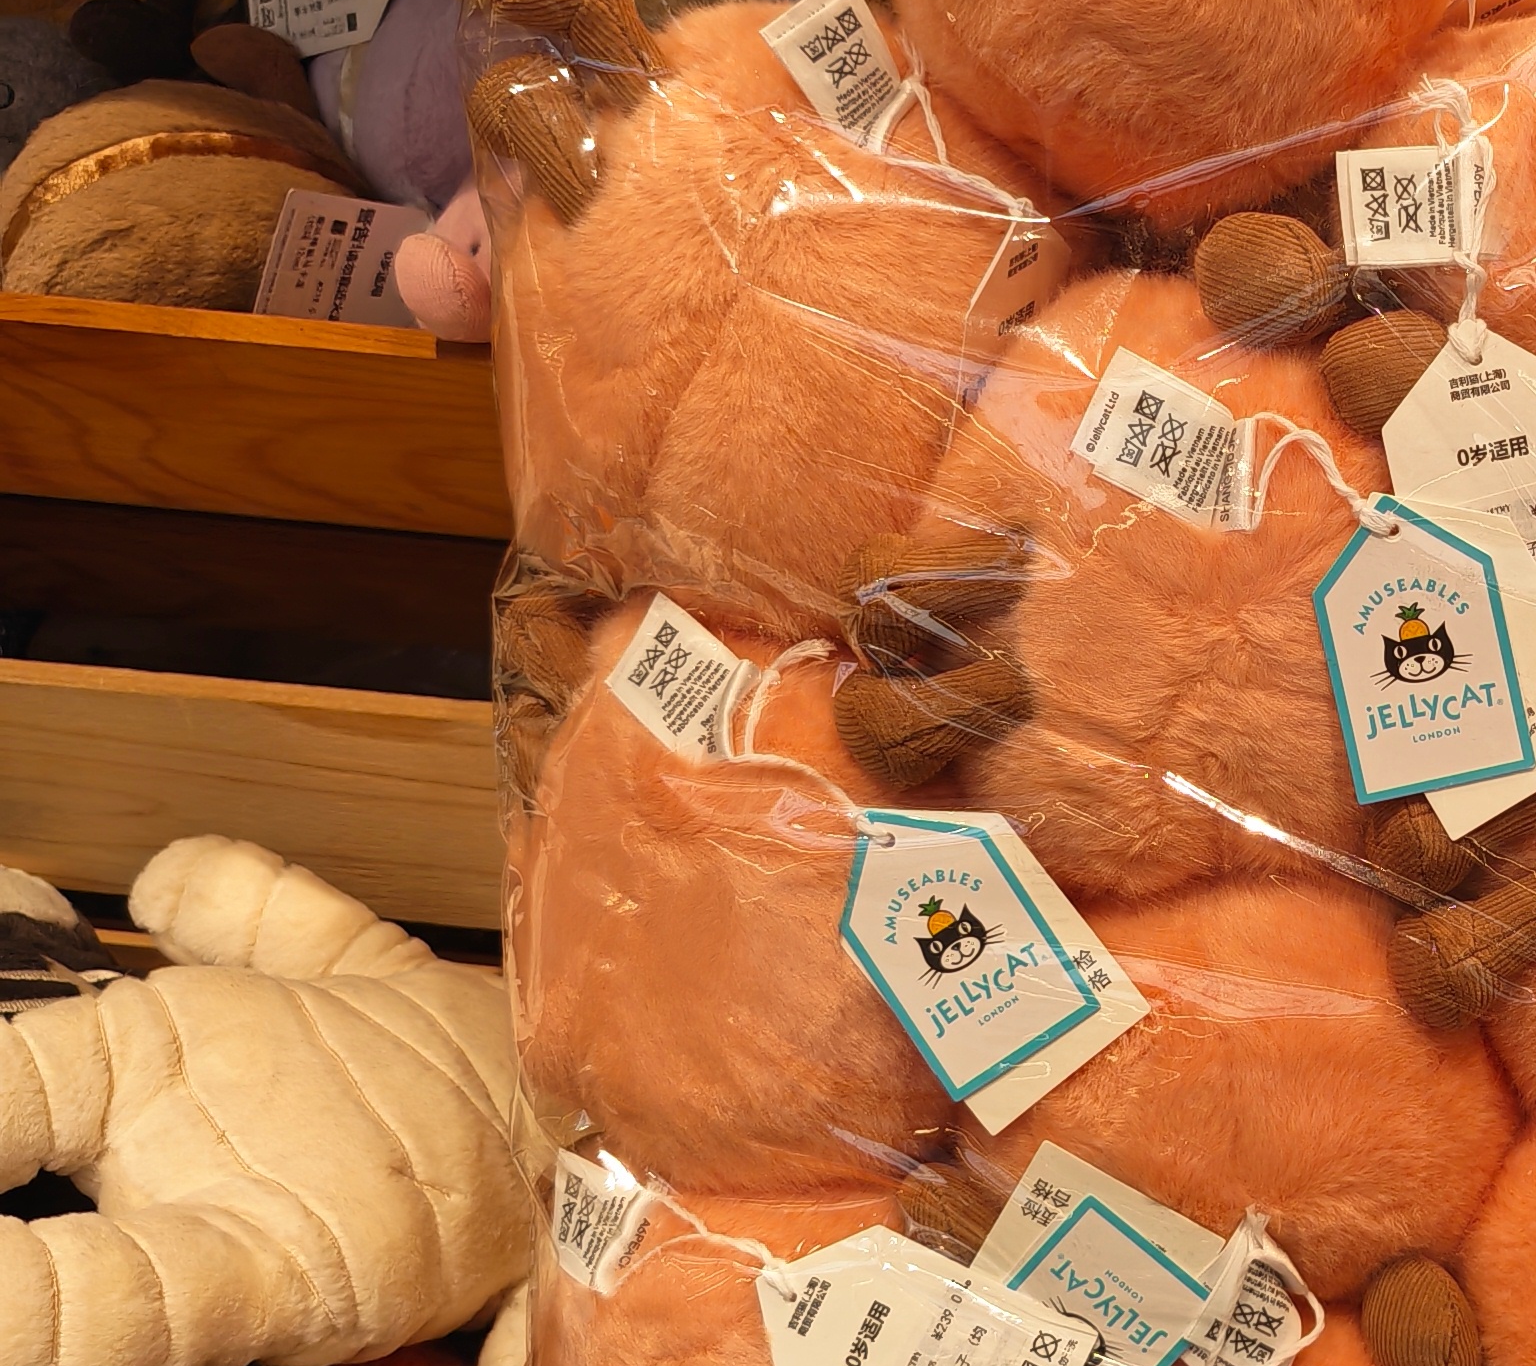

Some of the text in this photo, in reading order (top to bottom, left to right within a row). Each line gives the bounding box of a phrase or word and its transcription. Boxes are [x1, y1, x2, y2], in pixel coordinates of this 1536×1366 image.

[1456, 435, 1530, 466] 0岁适用
[1353, 577, 1470, 635] AMUSEABLES
[1366, 682, 1496, 740] JELLYCAT
[1412, 726, 1461, 743] LONDON
[883, 868, 983, 945] AMUSEABLES
[1073, 949, 1097, 974] 检
[925, 942, 1037, 1038] JELLYCAT
[1087, 968, 1113, 993] 格
[978, 995, 1020, 1027] LONDON
[1031, 1177, 1071, 1209] 合格
[1104, 1268, 1144, 1303] LONDON
[1050, 1257, 1168, 1354] JELLYCAT
